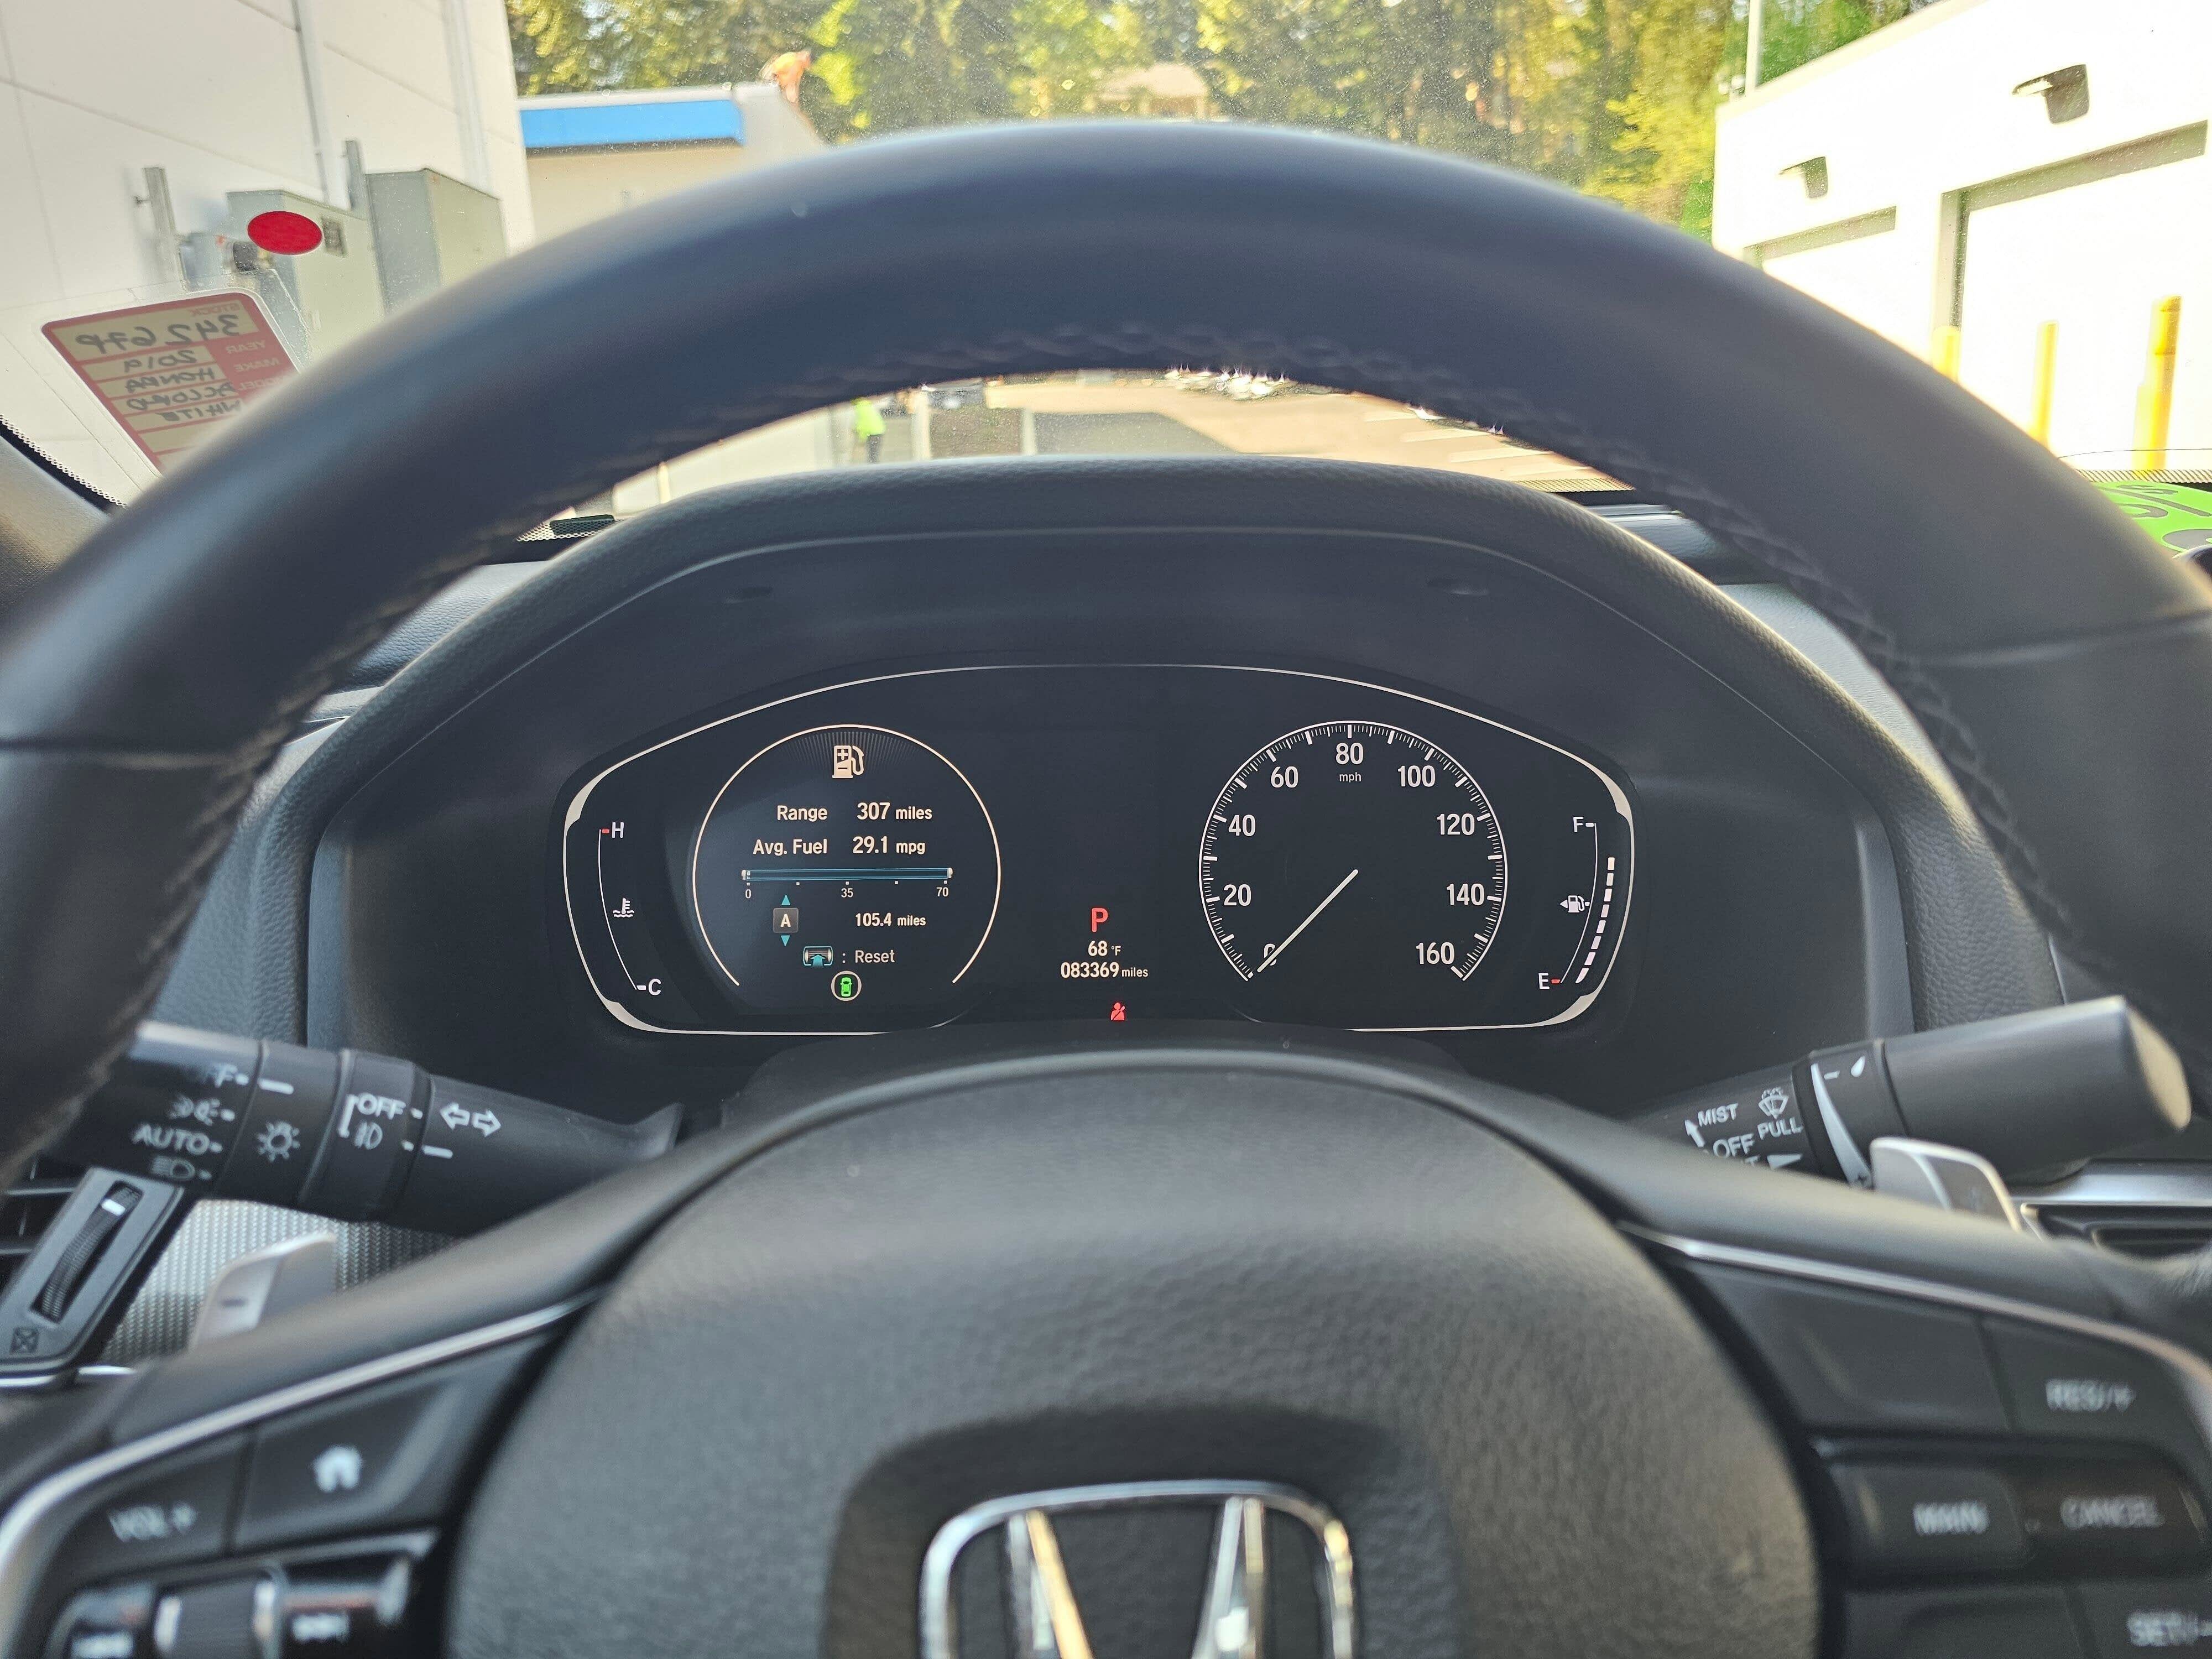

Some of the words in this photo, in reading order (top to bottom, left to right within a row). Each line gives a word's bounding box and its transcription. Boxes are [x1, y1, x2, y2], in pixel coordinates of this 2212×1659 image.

[1335, 742, 1364, 765] 80
[1270, 766, 1298, 788] 60
[1339, 771, 1361, 783] mph
[1397, 765, 1436, 787] 100
[777, 805, 828, 822] Range
[857, 802, 890, 820] 307
[895, 806, 932, 820] miles
[612, 821, 624, 838] H
[1228, 814, 1256, 837] 40
[1437, 813, 1475, 836] 120
[1573, 816, 1584, 833] F
[753, 839, 787, 856] Avg.
[792, 838, 827, 854] Fuel
[853, 836, 888, 854] 29.1
[896, 842, 925, 855] mpg
[745, 889, 752, 899] 0
[841, 888, 854, 898] 35
[936, 886, 949, 897] 70
[1223, 884, 1251, 906] 20
[1446, 883, 1485, 906] 140
[780, 914, 791, 927] A
[855, 912, 892, 927] 105.4
[897, 915, 926, 926] miles
[1092, 907, 1108, 932] P
[855, 950, 895, 963] Reset
[1088, 940, 1108, 957] 68
[1416, 942, 1455, 964] 160
[1061, 962, 1120, 978] 083369
[1121, 967, 1149, 977] miles
[648, 978, 661, 996] C
[1538, 972, 1550, 989] E
[357, 1093, 406, 1118] OFF
[1697, 1103, 1738, 1127] MIST
[1757, 1117, 1804, 1140] PULL
[131, 1125, 209, 1155] AUTO
[1712, 1133, 1756, 1159] OFF
